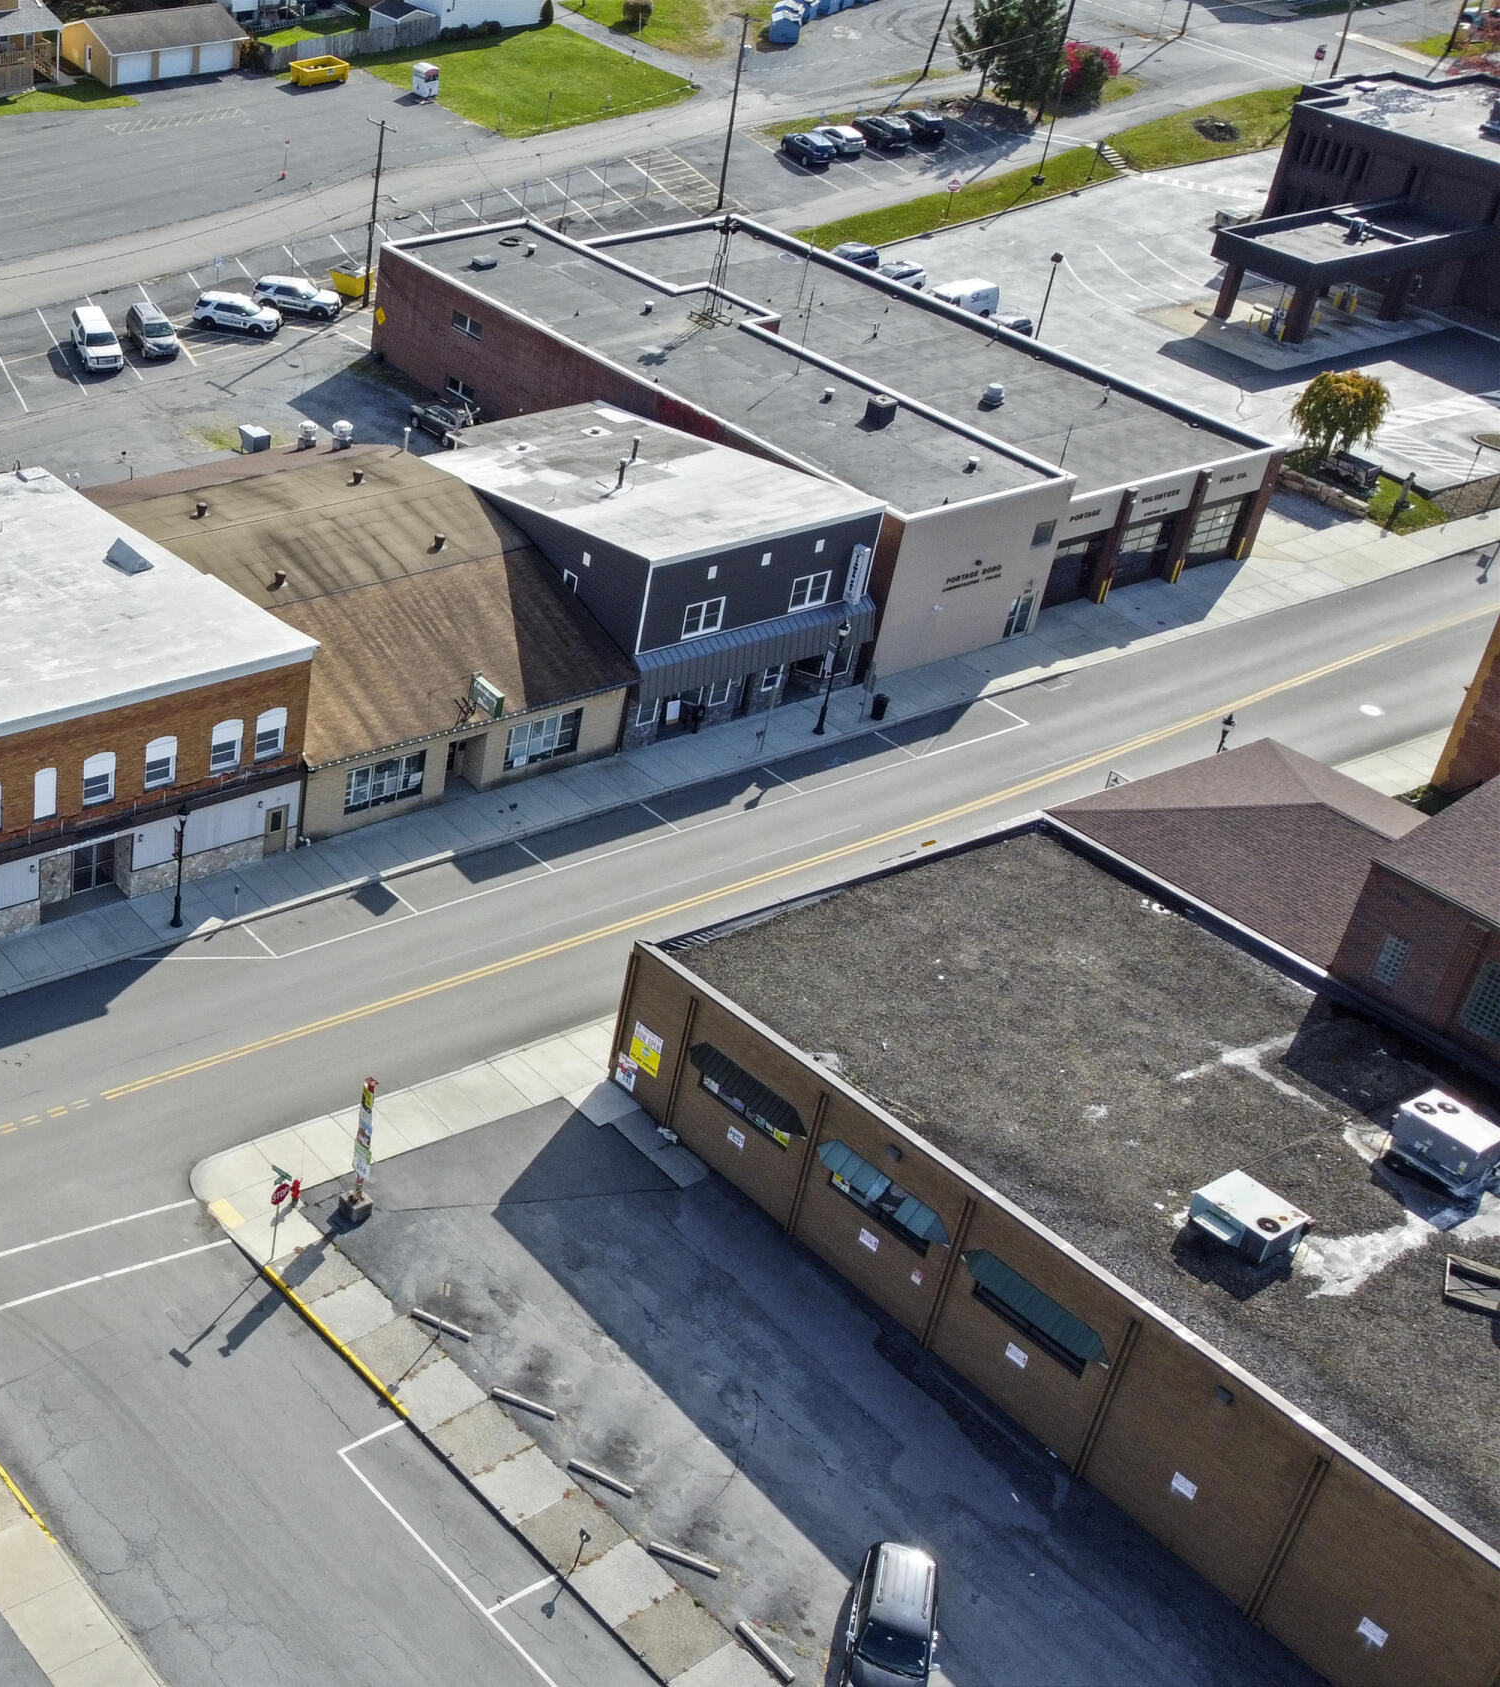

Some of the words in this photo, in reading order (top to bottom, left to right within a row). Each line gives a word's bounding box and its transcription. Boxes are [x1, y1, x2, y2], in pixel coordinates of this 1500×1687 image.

[1070, 508, 1102, 522] PORTAGE
[1141, 488, 1181, 504] VOLUNTEER
[1220, 474, 1235, 484] FIRE
[946, 570, 979, 584] PORTAGE
[981, 564, 1002, 575] BORO
[271, 1187, 290, 1202] STOP
